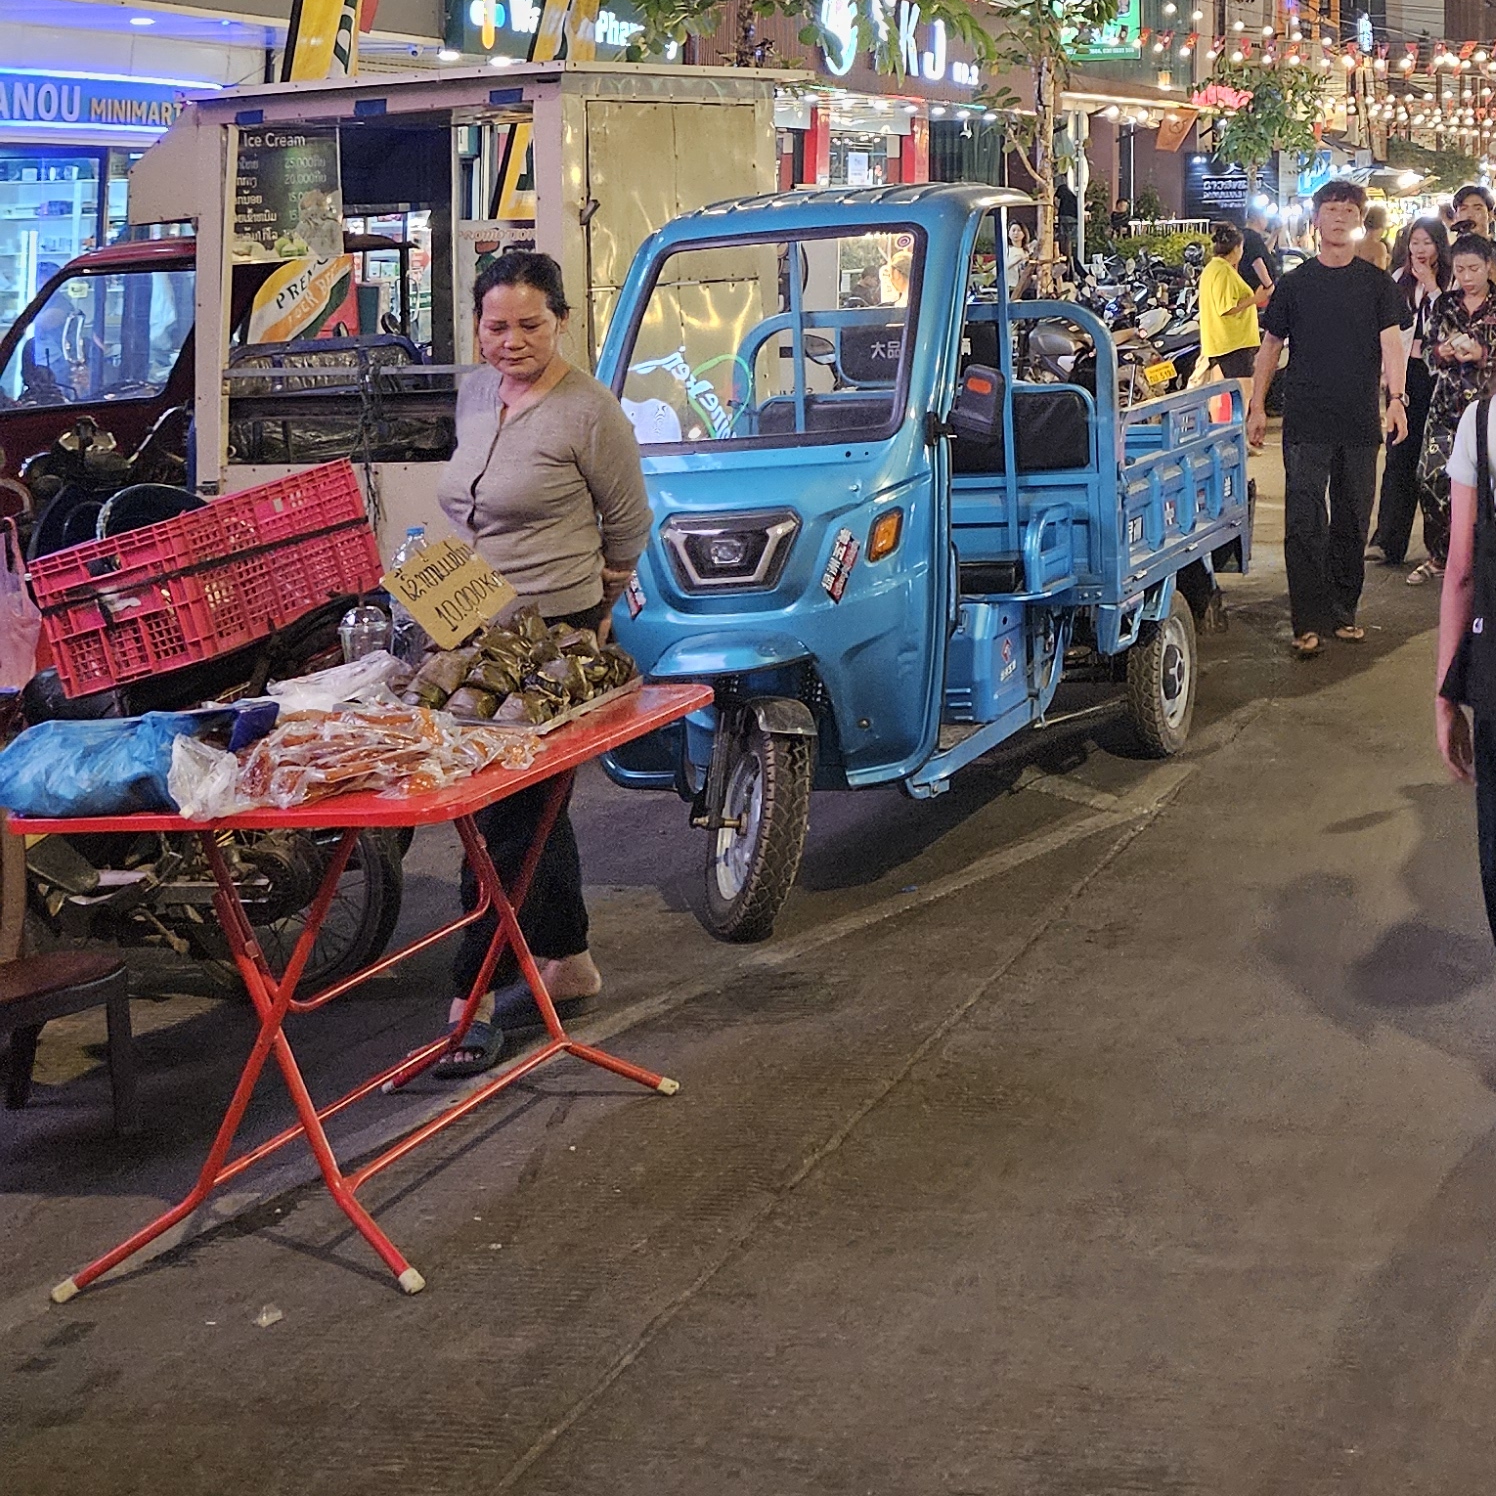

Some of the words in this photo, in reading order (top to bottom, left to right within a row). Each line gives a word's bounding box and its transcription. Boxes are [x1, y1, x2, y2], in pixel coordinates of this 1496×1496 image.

[90, 97, 183, 126] MINIMART
[243, 132, 262, 147] Ice
[265, 132, 306, 147] Cream
